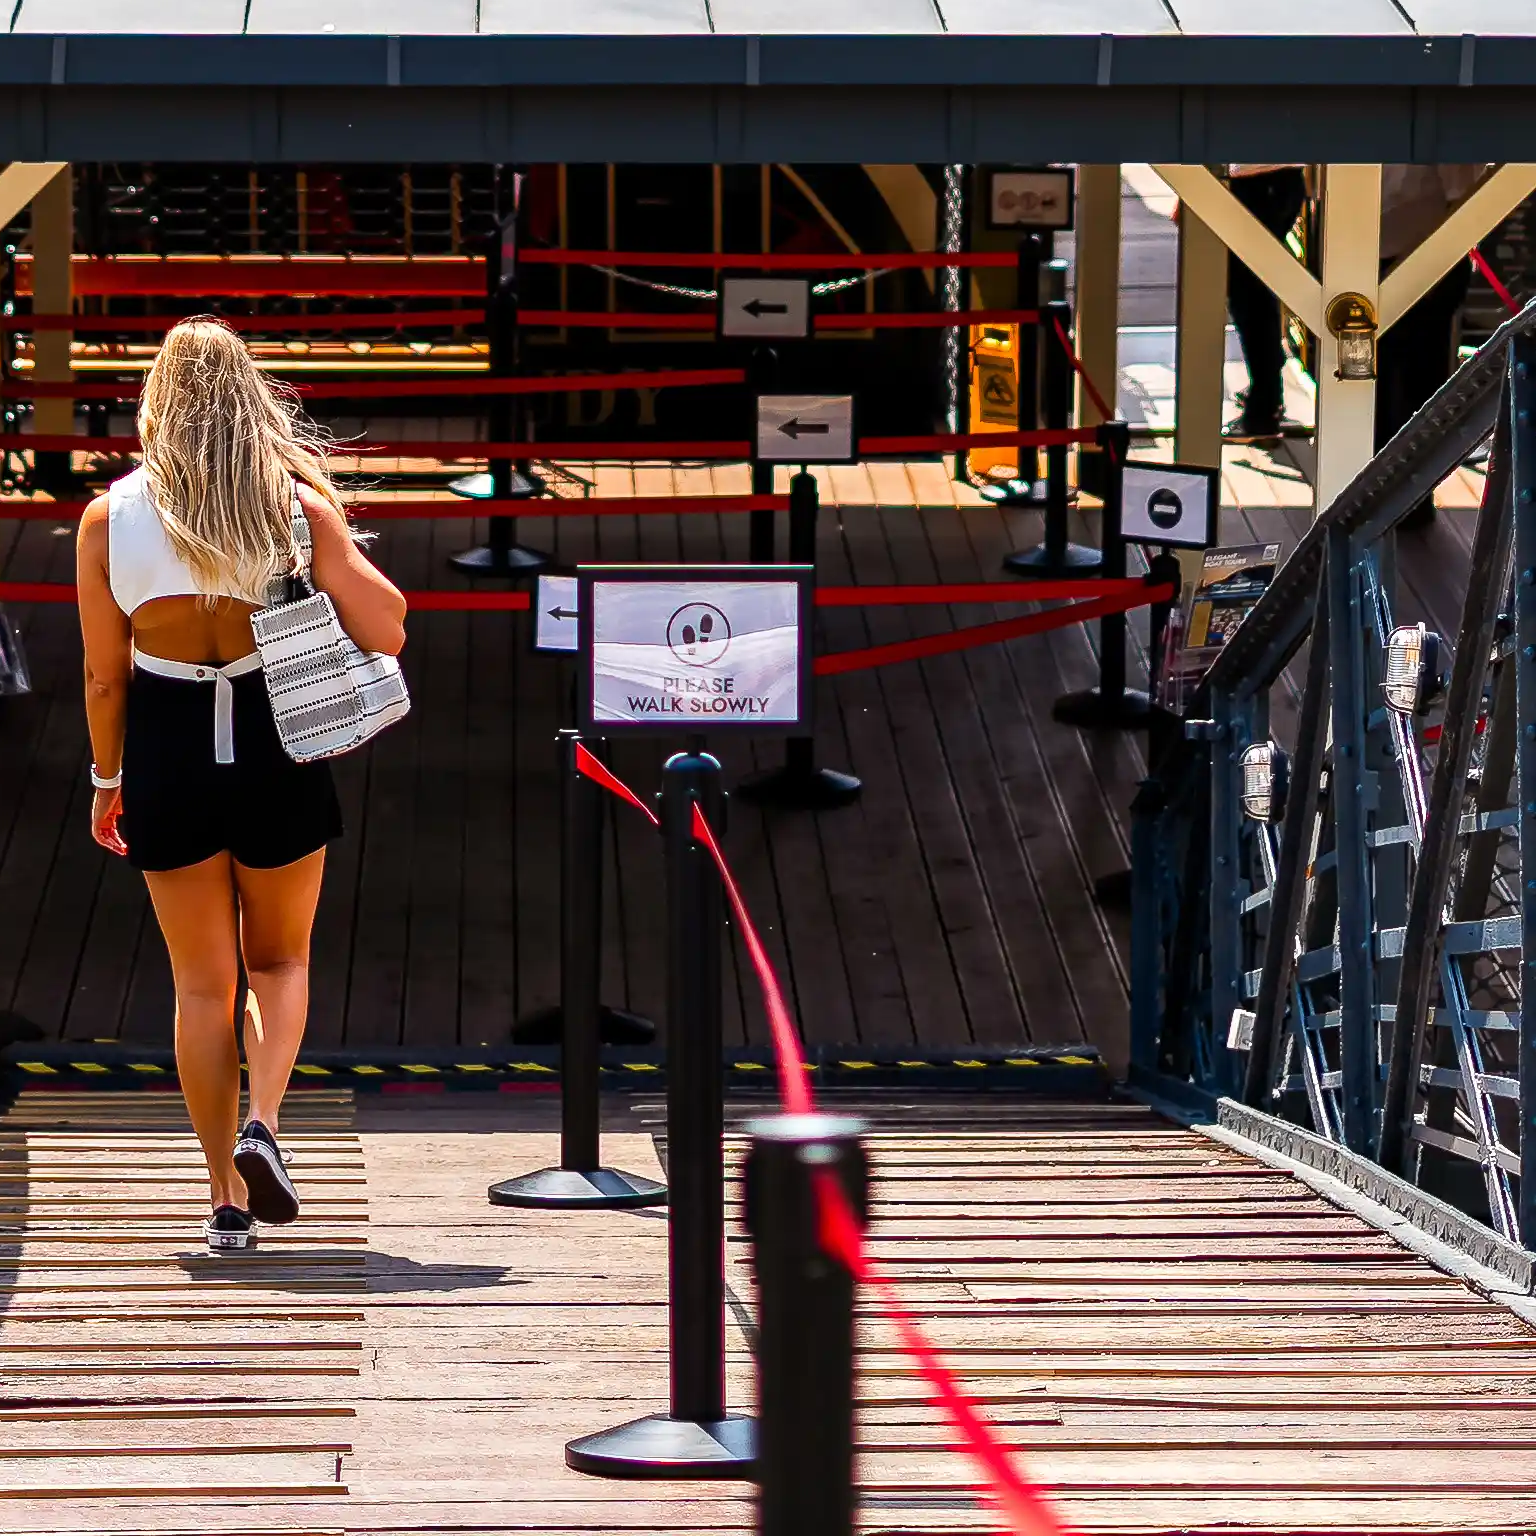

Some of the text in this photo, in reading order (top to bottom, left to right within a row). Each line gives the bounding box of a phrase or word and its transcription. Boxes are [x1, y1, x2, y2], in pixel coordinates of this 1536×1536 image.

[664, 677, 734, 693] PLEASE
[627, 696, 769, 713] WALK SLOWLY
